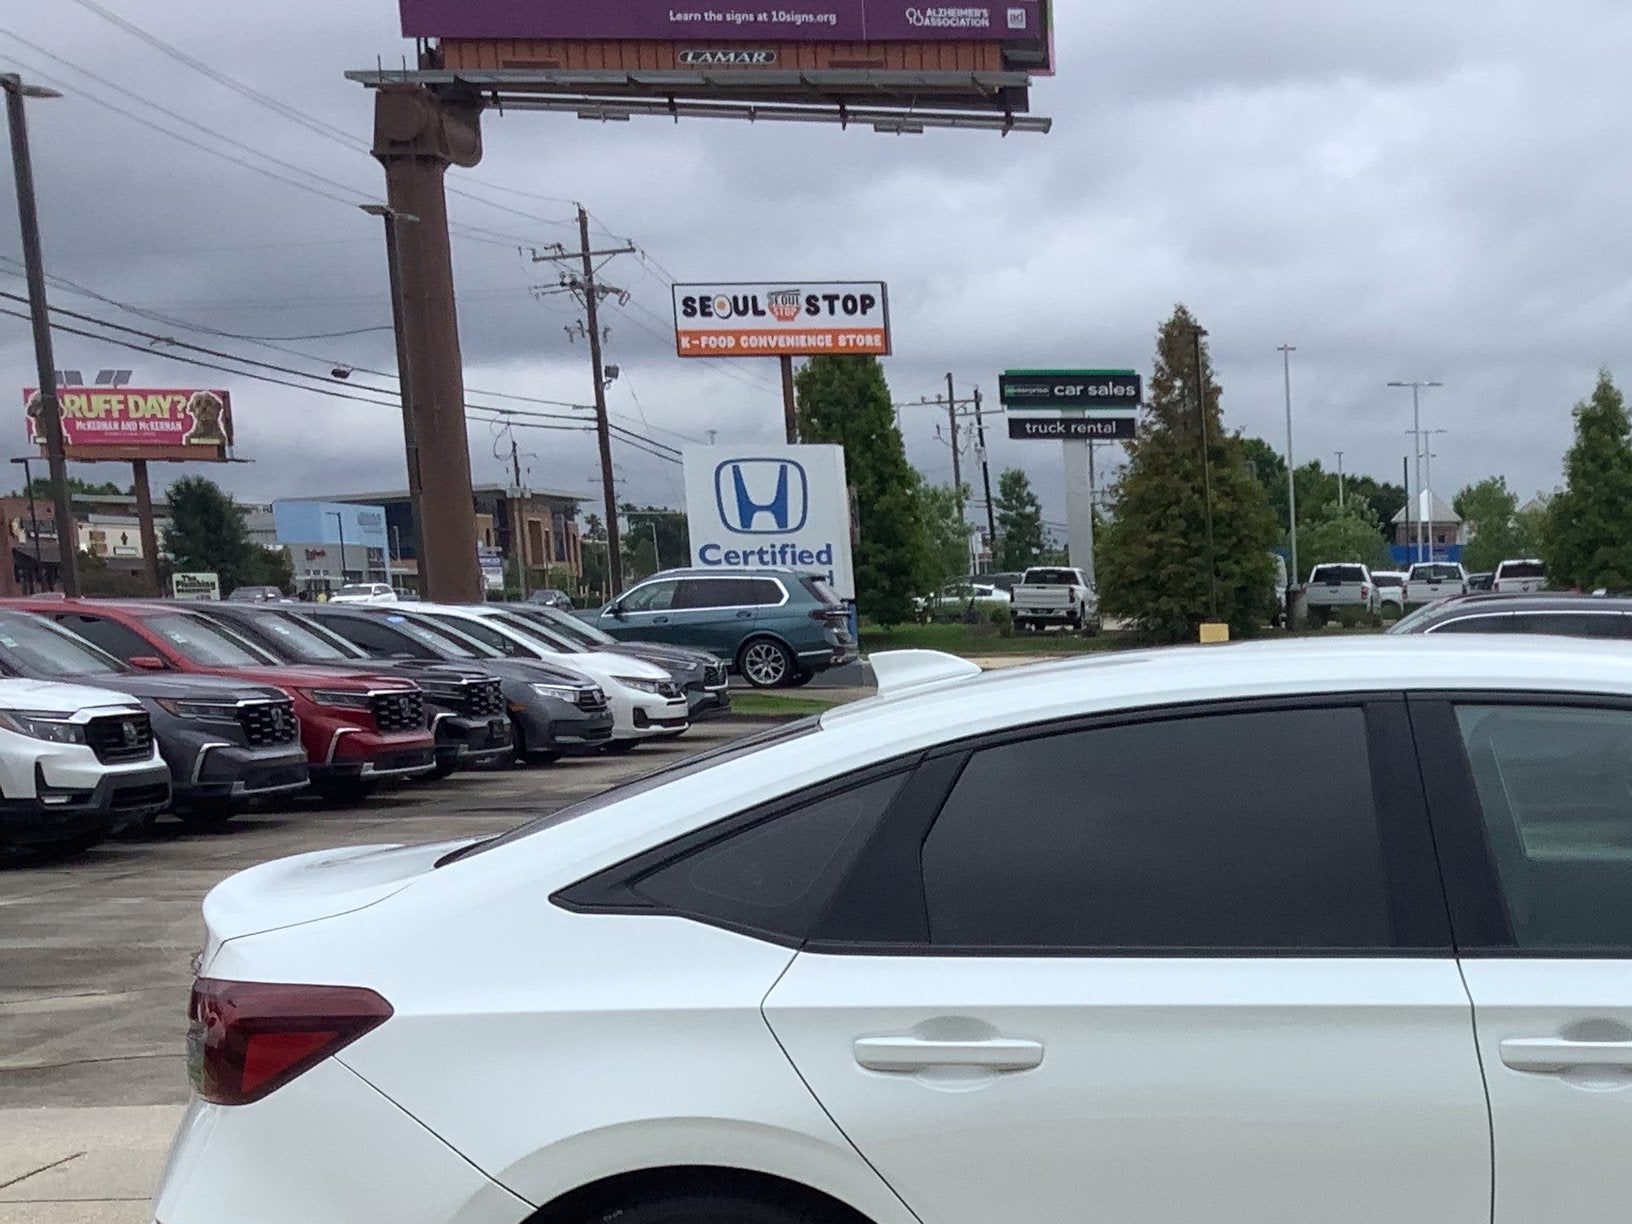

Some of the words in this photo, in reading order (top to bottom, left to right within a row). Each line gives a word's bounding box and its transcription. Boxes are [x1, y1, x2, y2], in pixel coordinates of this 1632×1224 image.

[669, 10, 701, 22] Learn
[704, 10, 723, 22] the
[726, 10, 754, 25] signs
[756, 11, 769, 22] at
[771, 10, 837, 25] 10signs.org
[924, 17, 990, 27] ASSOCIATION
[687, 51, 767, 64] LAMAR
[681, 294, 766, 319] SEOUL
[805, 293, 876, 316] STOP
[680, 335, 735, 349] K-FOOD
[740, 334, 833, 348] CONVENIENCE
[838, 334, 882, 347] STORE
[1053, 385, 1084, 396] car
[1088, 381, 1136, 396] sales
[63, 394, 124, 418] RUFF
[127, 394, 187, 419] DAY?
[121, 421, 137, 431] AND
[1025, 421, 1066, 434] truck
[1071, 421, 1116, 434] rental
[698, 543, 833, 565] Certified
